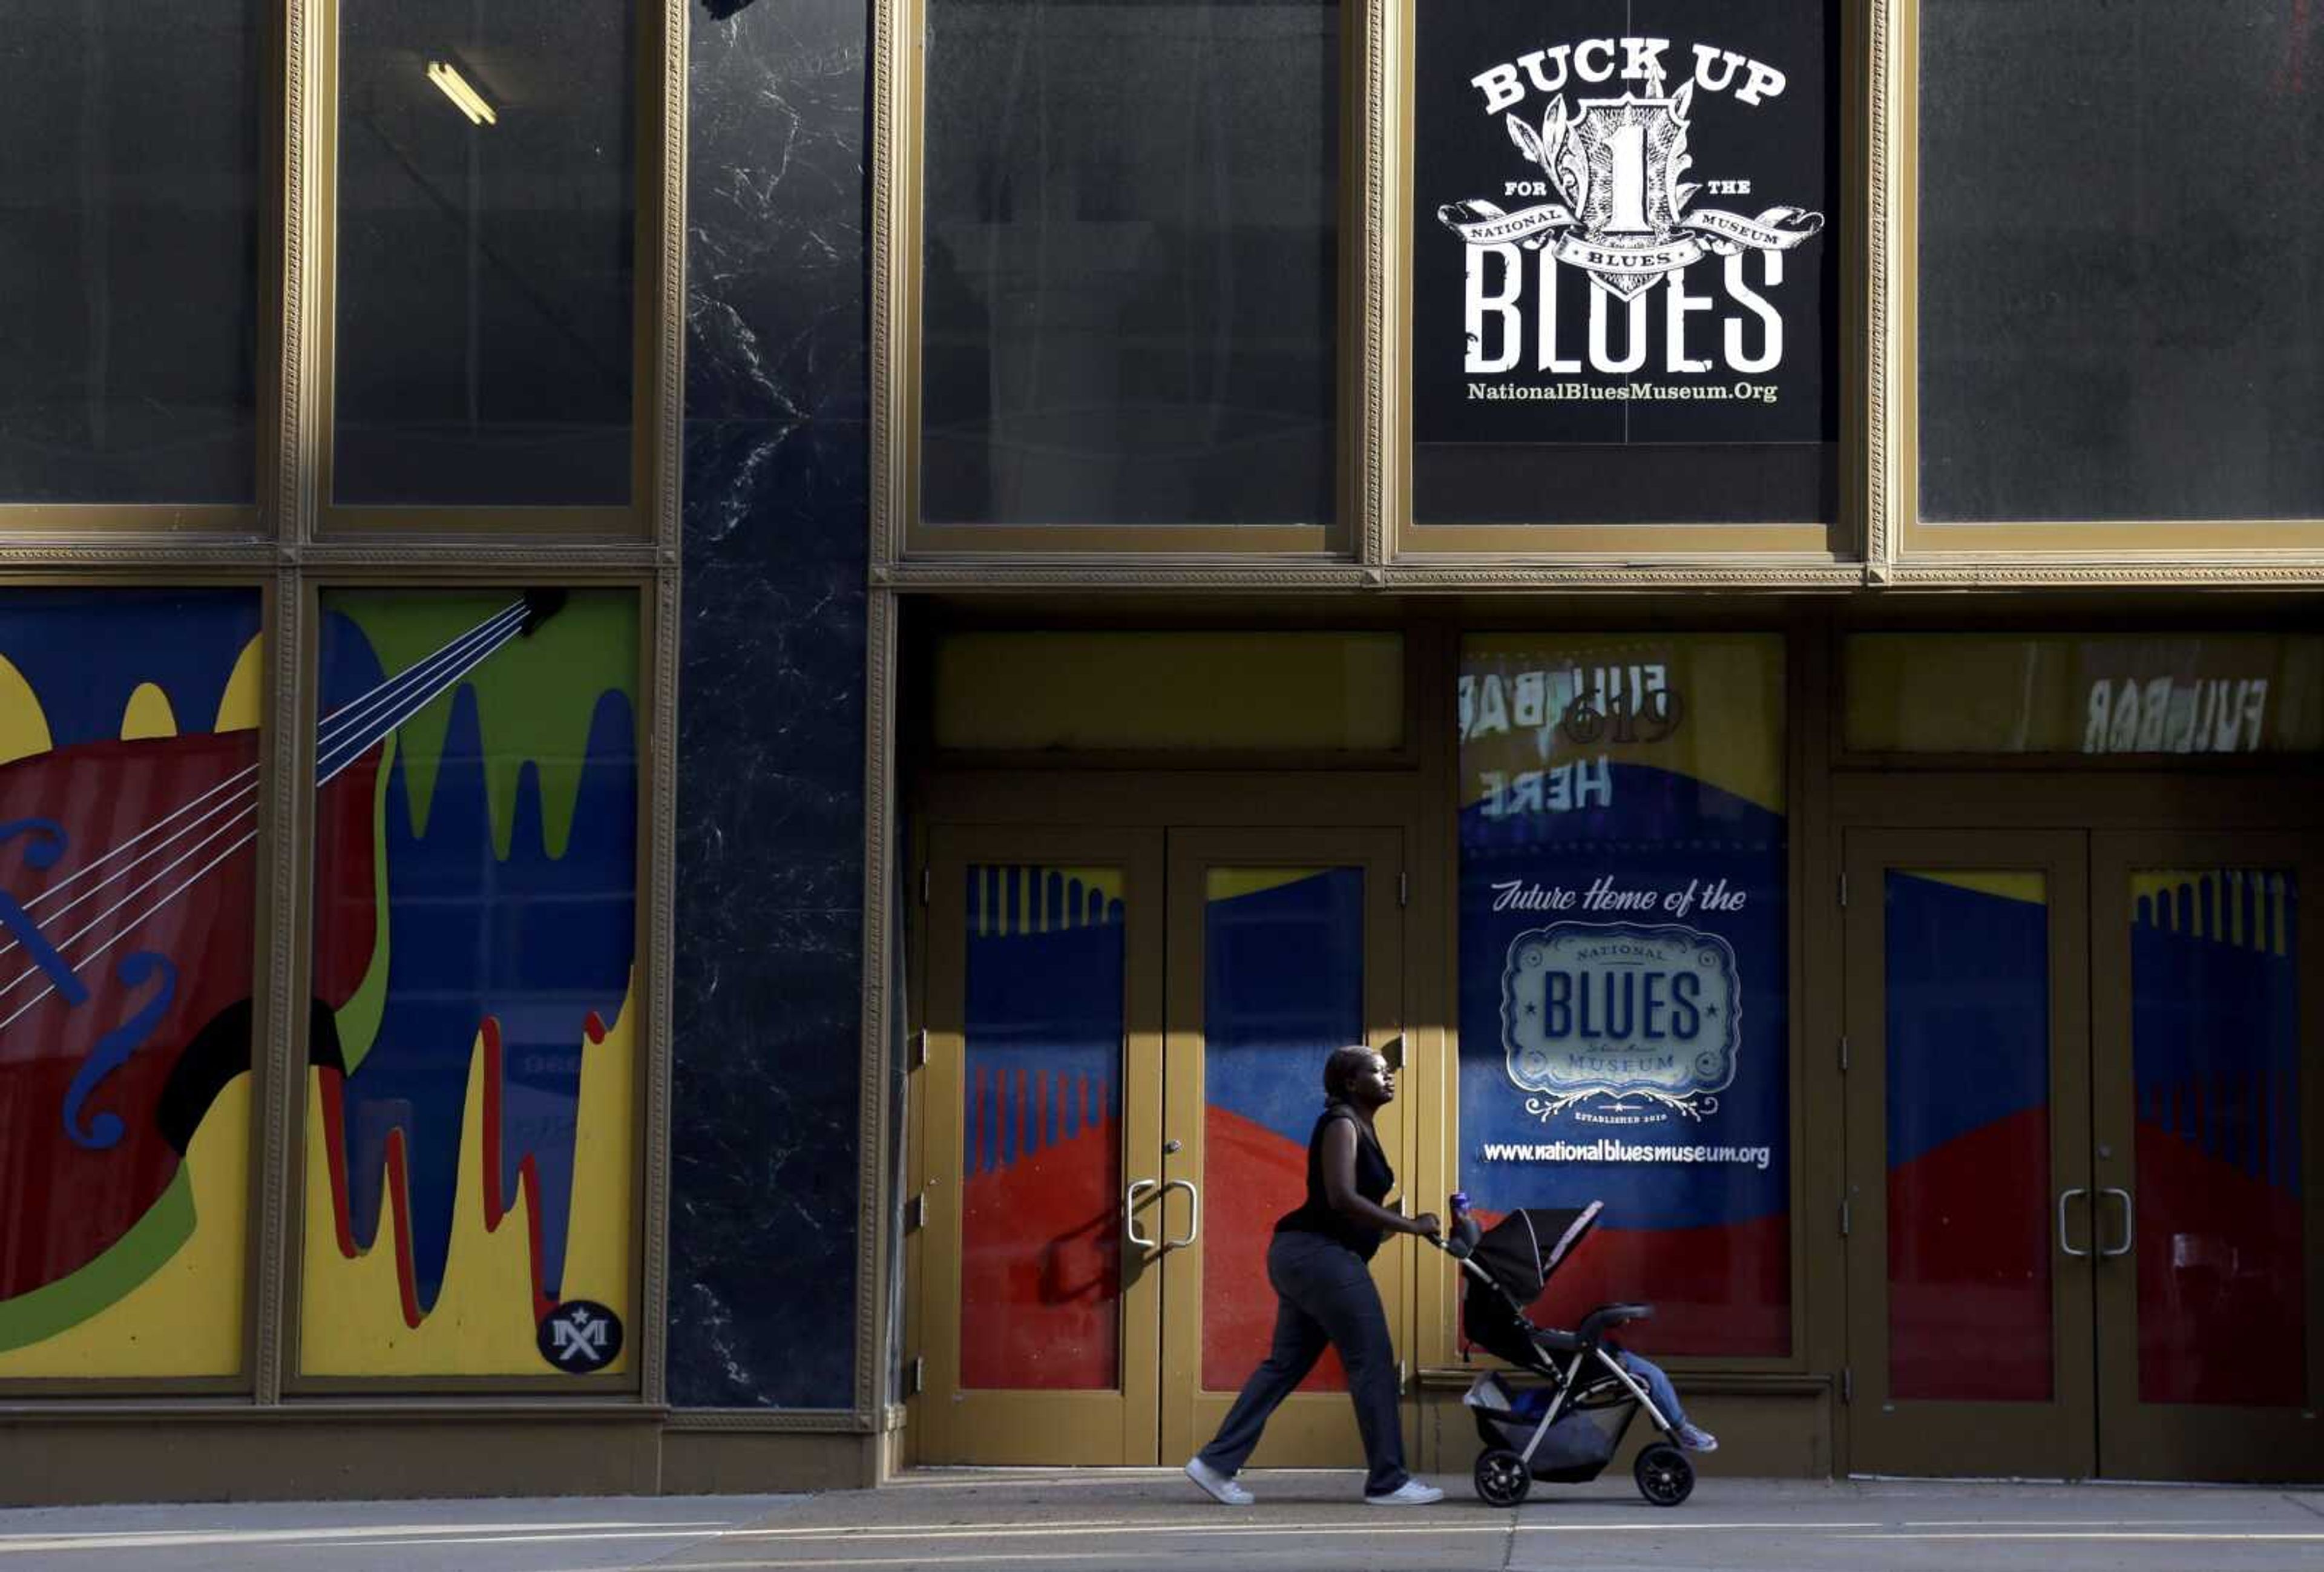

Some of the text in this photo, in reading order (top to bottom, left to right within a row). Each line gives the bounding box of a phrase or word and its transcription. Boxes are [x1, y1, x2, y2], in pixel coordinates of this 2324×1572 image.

[1471, 37, 1787, 115] BUCK UP
[1505, 182, 1548, 196] FOR
[1708, 180, 1751, 194] THE
[1470, 209, 1562, 239] NATIONAL
[1701, 212, 1778, 245] MUSEUM
[1587, 251, 1672, 267] BLUES
[1464, 238, 1783, 373] BLUES
[1467, 382, 1777, 403] NationalBluesMuseum.Org
[1491, 875, 1747, 918] Future Home of the
[1577, 944, 1669, 961] NATIONAL
[1544, 970, 1701, 1041] BLUES
[1568, 1053, 1675, 1072] MUSEUM
[1575, 1112, 1640, 1124] ESTABLISHED
[1484, 1139, 1771, 1169] www.nationalbluesmuseum.org
